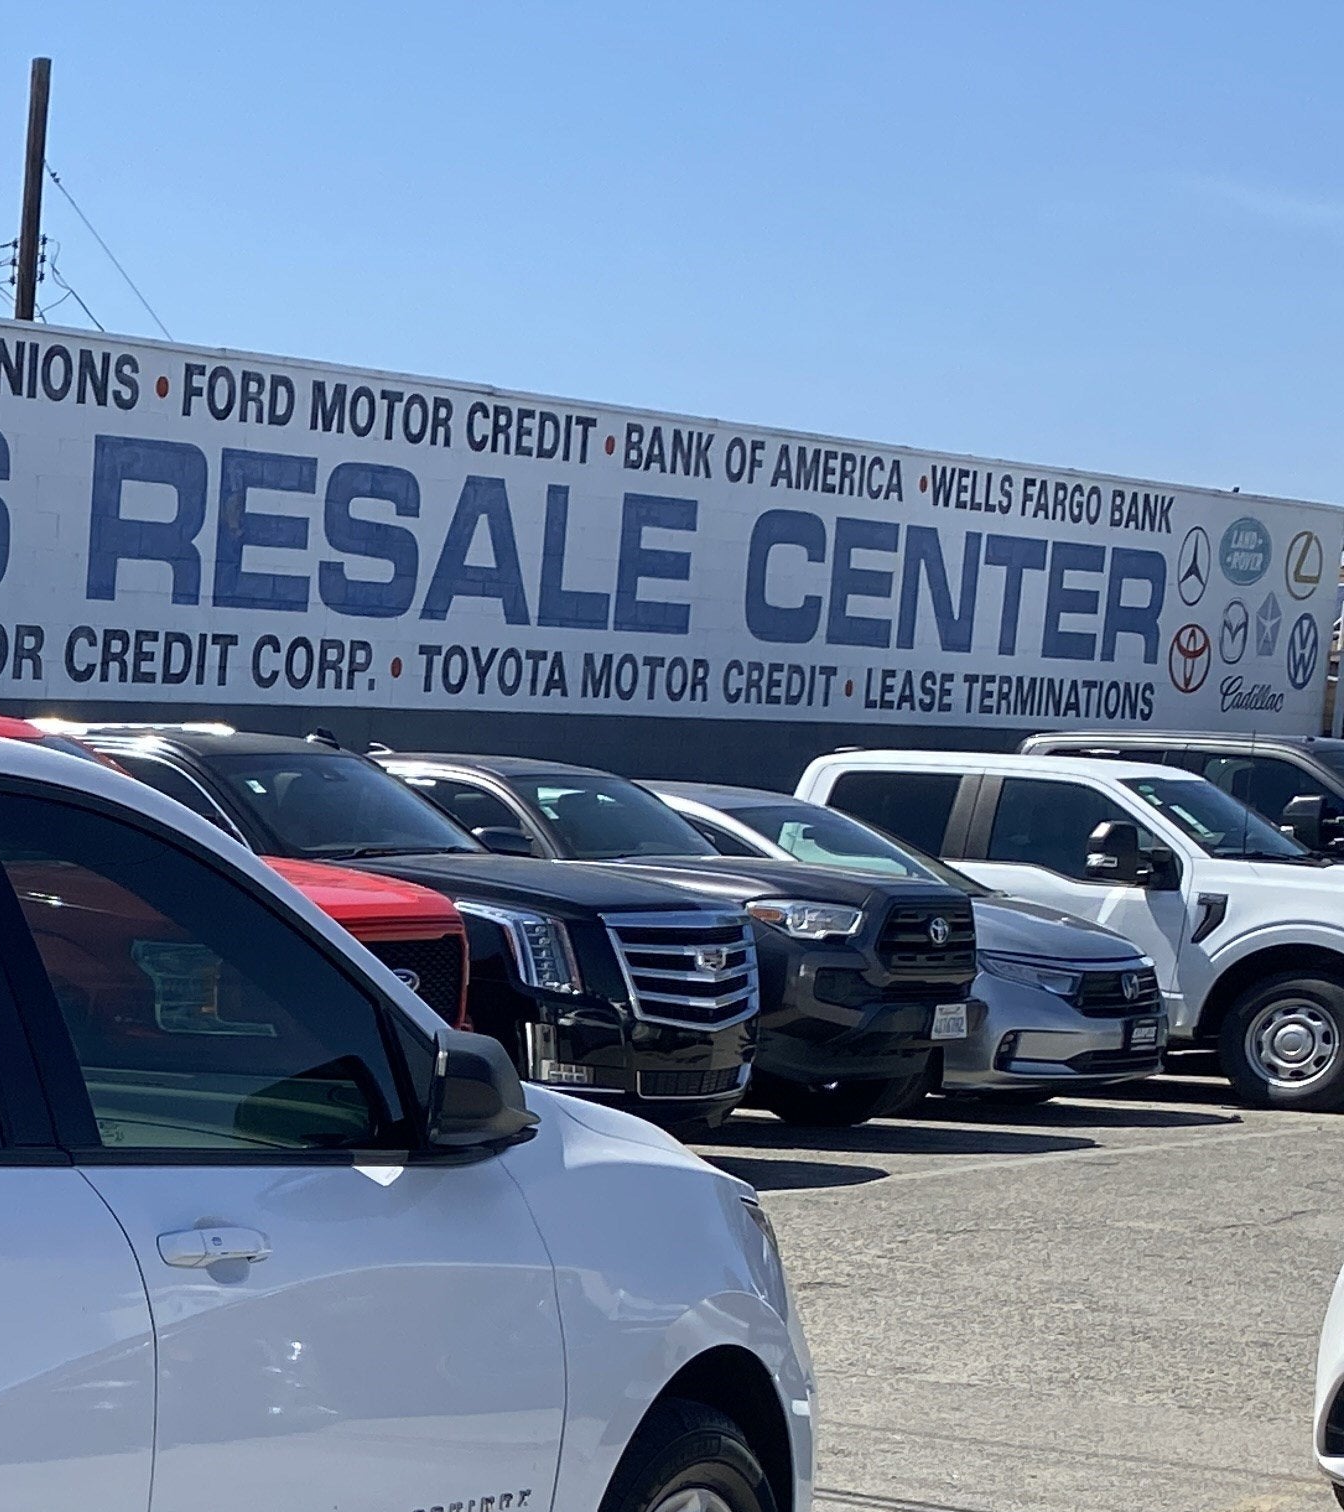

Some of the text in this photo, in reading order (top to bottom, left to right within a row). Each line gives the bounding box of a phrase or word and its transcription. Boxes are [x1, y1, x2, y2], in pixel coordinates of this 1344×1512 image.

[182, 363, 295, 426] FORD
[310, 380, 453, 447] MOTOR
[467, 401, 597, 464] CREDIT
[624, 422, 715, 478] BANK
[726, 436, 765, 485] OF
[770, 444, 903, 502] AMERICA
[931, 464, 1013, 514] WELLS
[1021, 475, 1101, 526] FARGO
[1110, 489, 1175, 534] BANK
[86, 434, 698, 635] RESALE
[745, 509, 1167, 665] CENTER
[65, 628, 238, 686] CREDIT
[252, 634, 375, 691] CORP.
[418, 645, 568, 697] TOYOTA
[581, 652, 710, 702] MOTOR
[722, 660, 837, 707] CREDIT
[864, 668, 954, 712] LEASE
[964, 674, 1155, 721] TERMINATIONS
[1220, 675, 1285, 713] Cadillac
